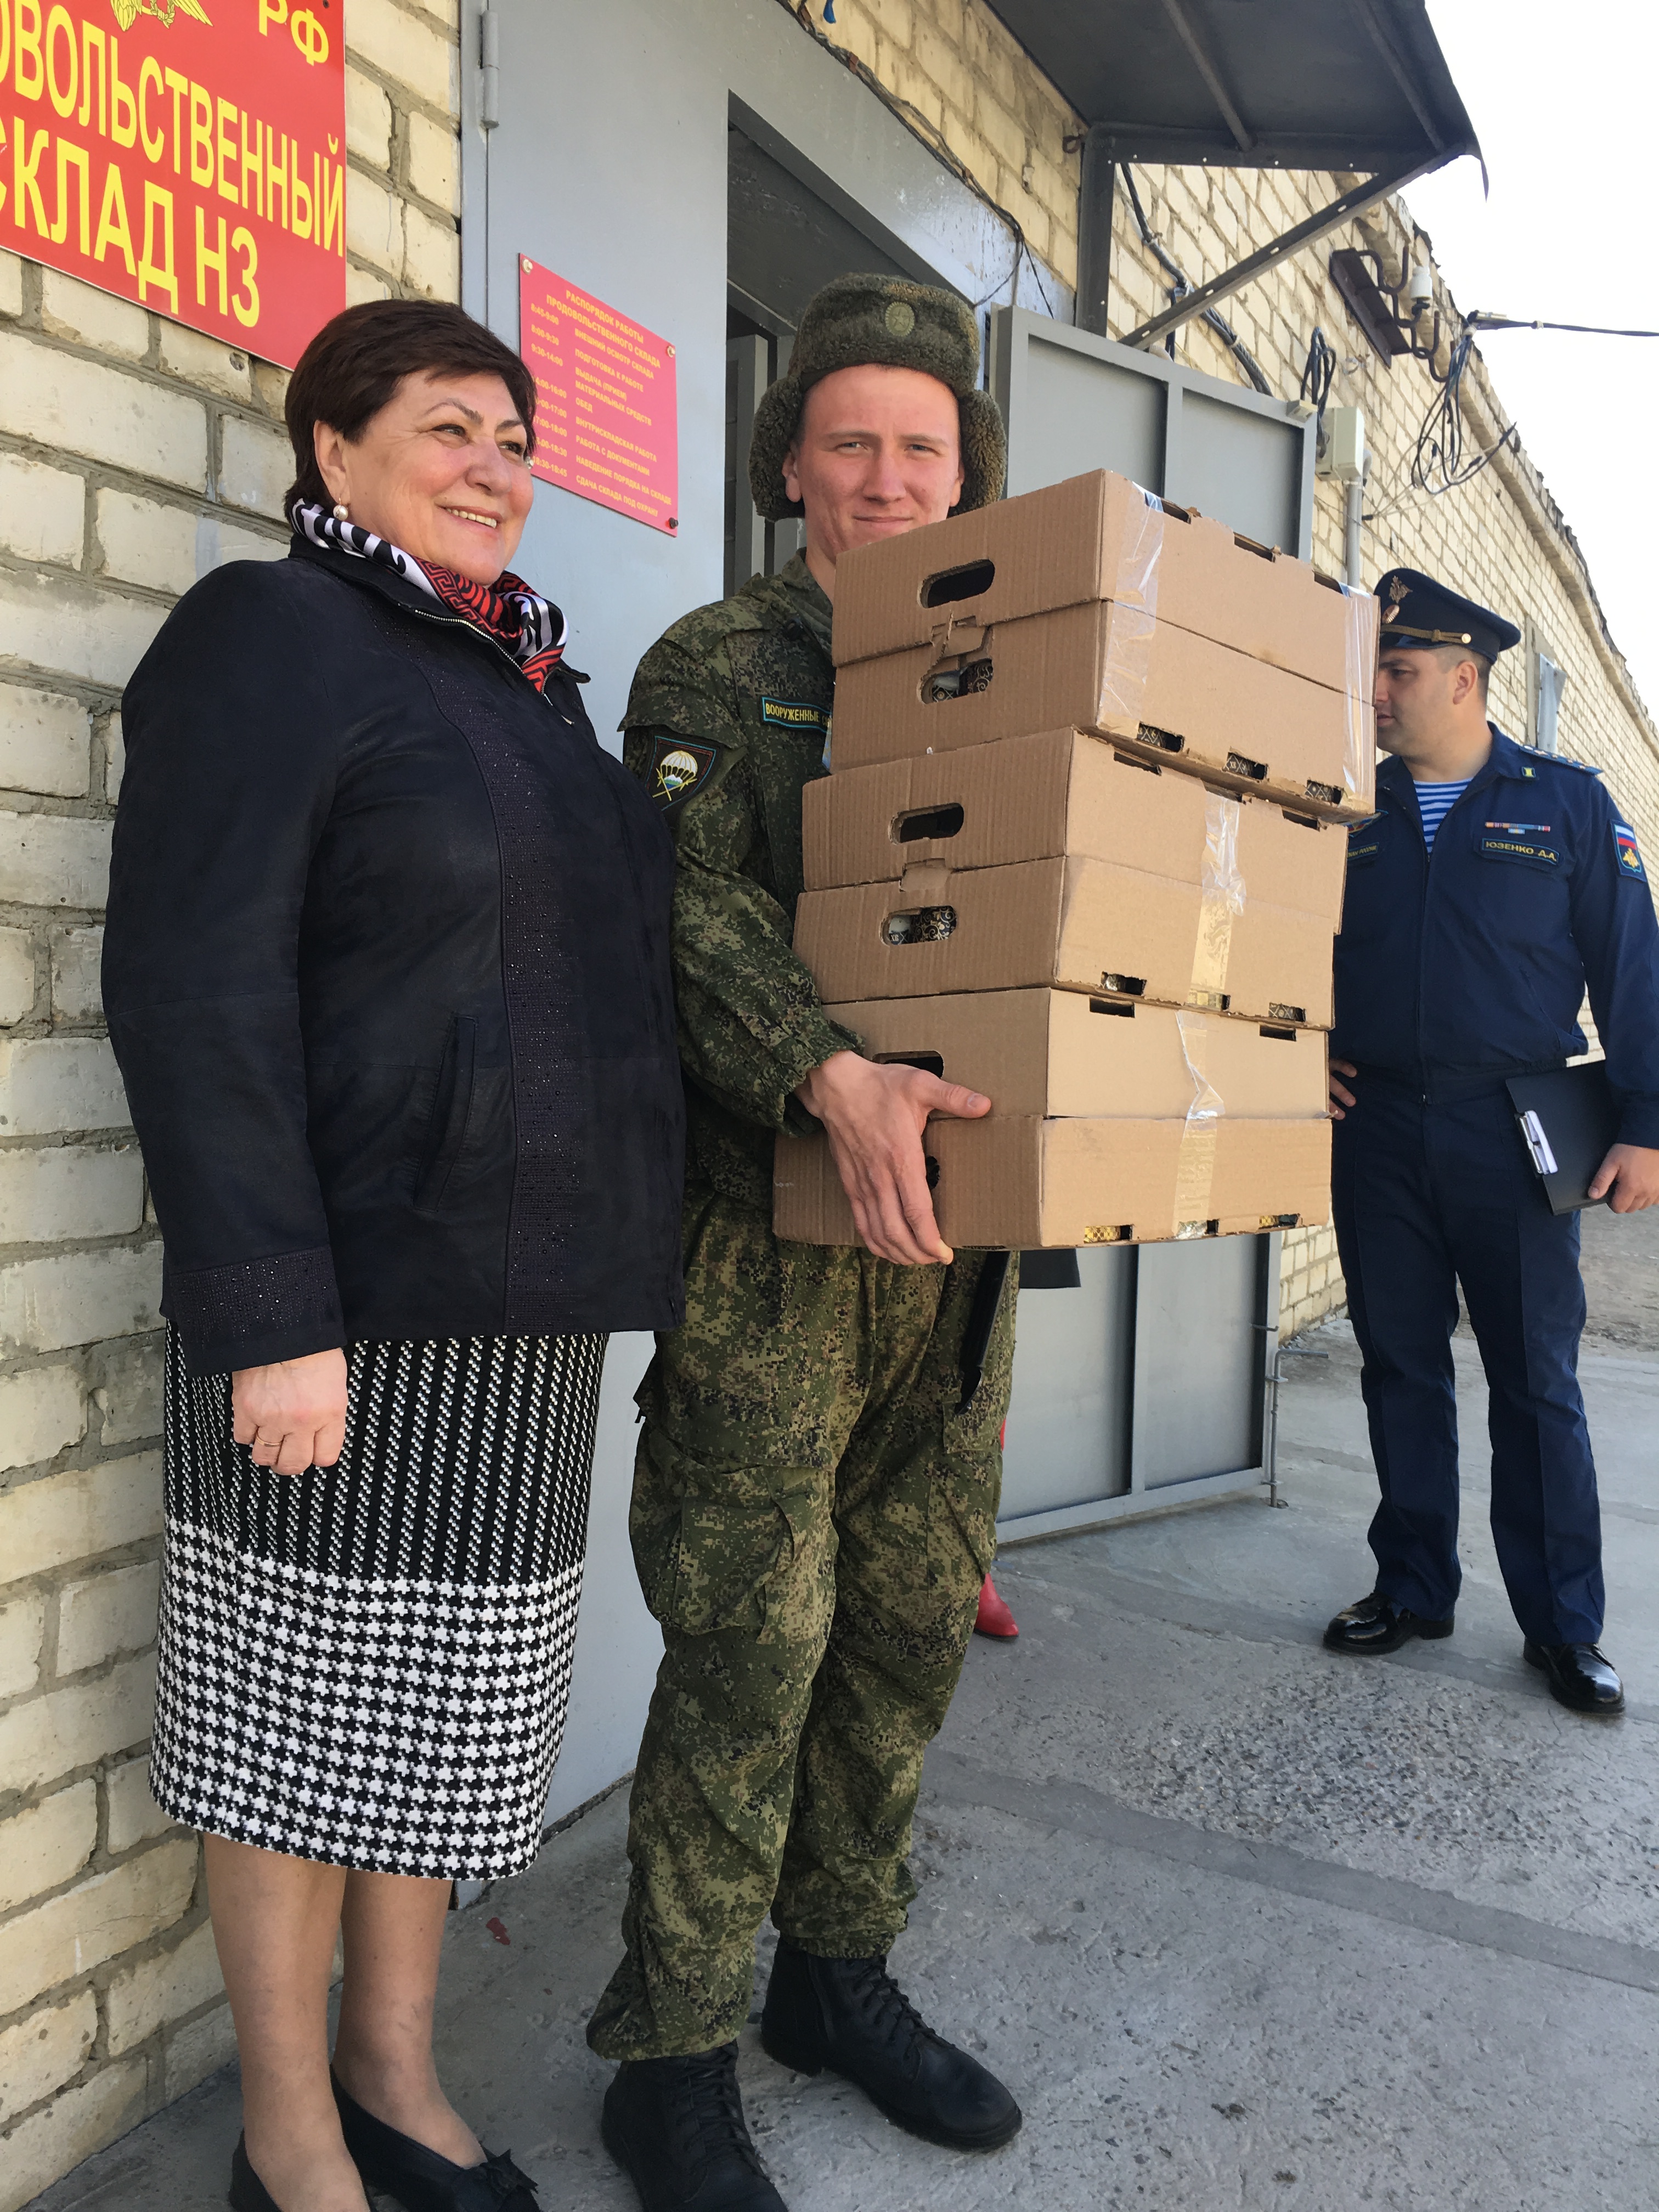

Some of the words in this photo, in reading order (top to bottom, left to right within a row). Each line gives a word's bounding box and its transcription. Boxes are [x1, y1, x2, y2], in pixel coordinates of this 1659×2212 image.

[259, 0, 329, 66] РФ
[0, 116, 179, 315] КЛАД
[546, 294, 633, 352] ПРОДОВОЛЬСТВЕННОГО
[634, 346, 661, 368] СКЛАДА
[566, 290, 614, 326] РАСПОРЯДОК
[616, 320, 644, 343] РАБОТЫ
[531, 303, 559, 325] 8:45-9:00
[575, 328, 606, 352] ВНЕШНИЙ
[607, 347, 631, 365] ОСМОТР
[631, 360, 654, 380] СКЛАДА
[531, 343, 563, 366] 9:30-14:00
[575, 367, 602, 387] ВЫДАЧА
[575, 348, 615, 376] ПОДГОТОВКА
[616, 371, 620, 380] К
[622, 374, 644, 392] РАБОТЕ
[575, 380, 625, 413] МАТЕРИАЛЬНЫХ
[626, 407, 652, 426] СРЕДСТВ
[575, 397, 592, 413] ОБЕД
[576, 416, 634, 451] ВНУТРИСКЛАДСКАЯ
[635, 446, 657, 462] РАБОТА
[576, 435, 600, 453] РАБОТА
[601, 447, 606, 456] С
[607, 450, 650, 476] ДОКУМЕНТАМИ
[536, 437, 567, 457] 8:00-18:30
[576, 455, 612, 478] НАВЕДЕНИЕ
[613, 472, 640, 490] ПОРЯДКА
[642, 485, 650, 495] НА
[651, 489, 672, 505] СКЛАДЕ
[576, 475, 597, 490] СДАЧА
[599, 484, 622, 501] СКЛАДА
[623, 496, 636, 509] ПОД
[637, 503, 658, 517] ОХРАНУ
[765, 703, 820, 722] ВООРУЖЕННЫЕ
[1486, 841, 1534, 855] ЮЗЕНКО
